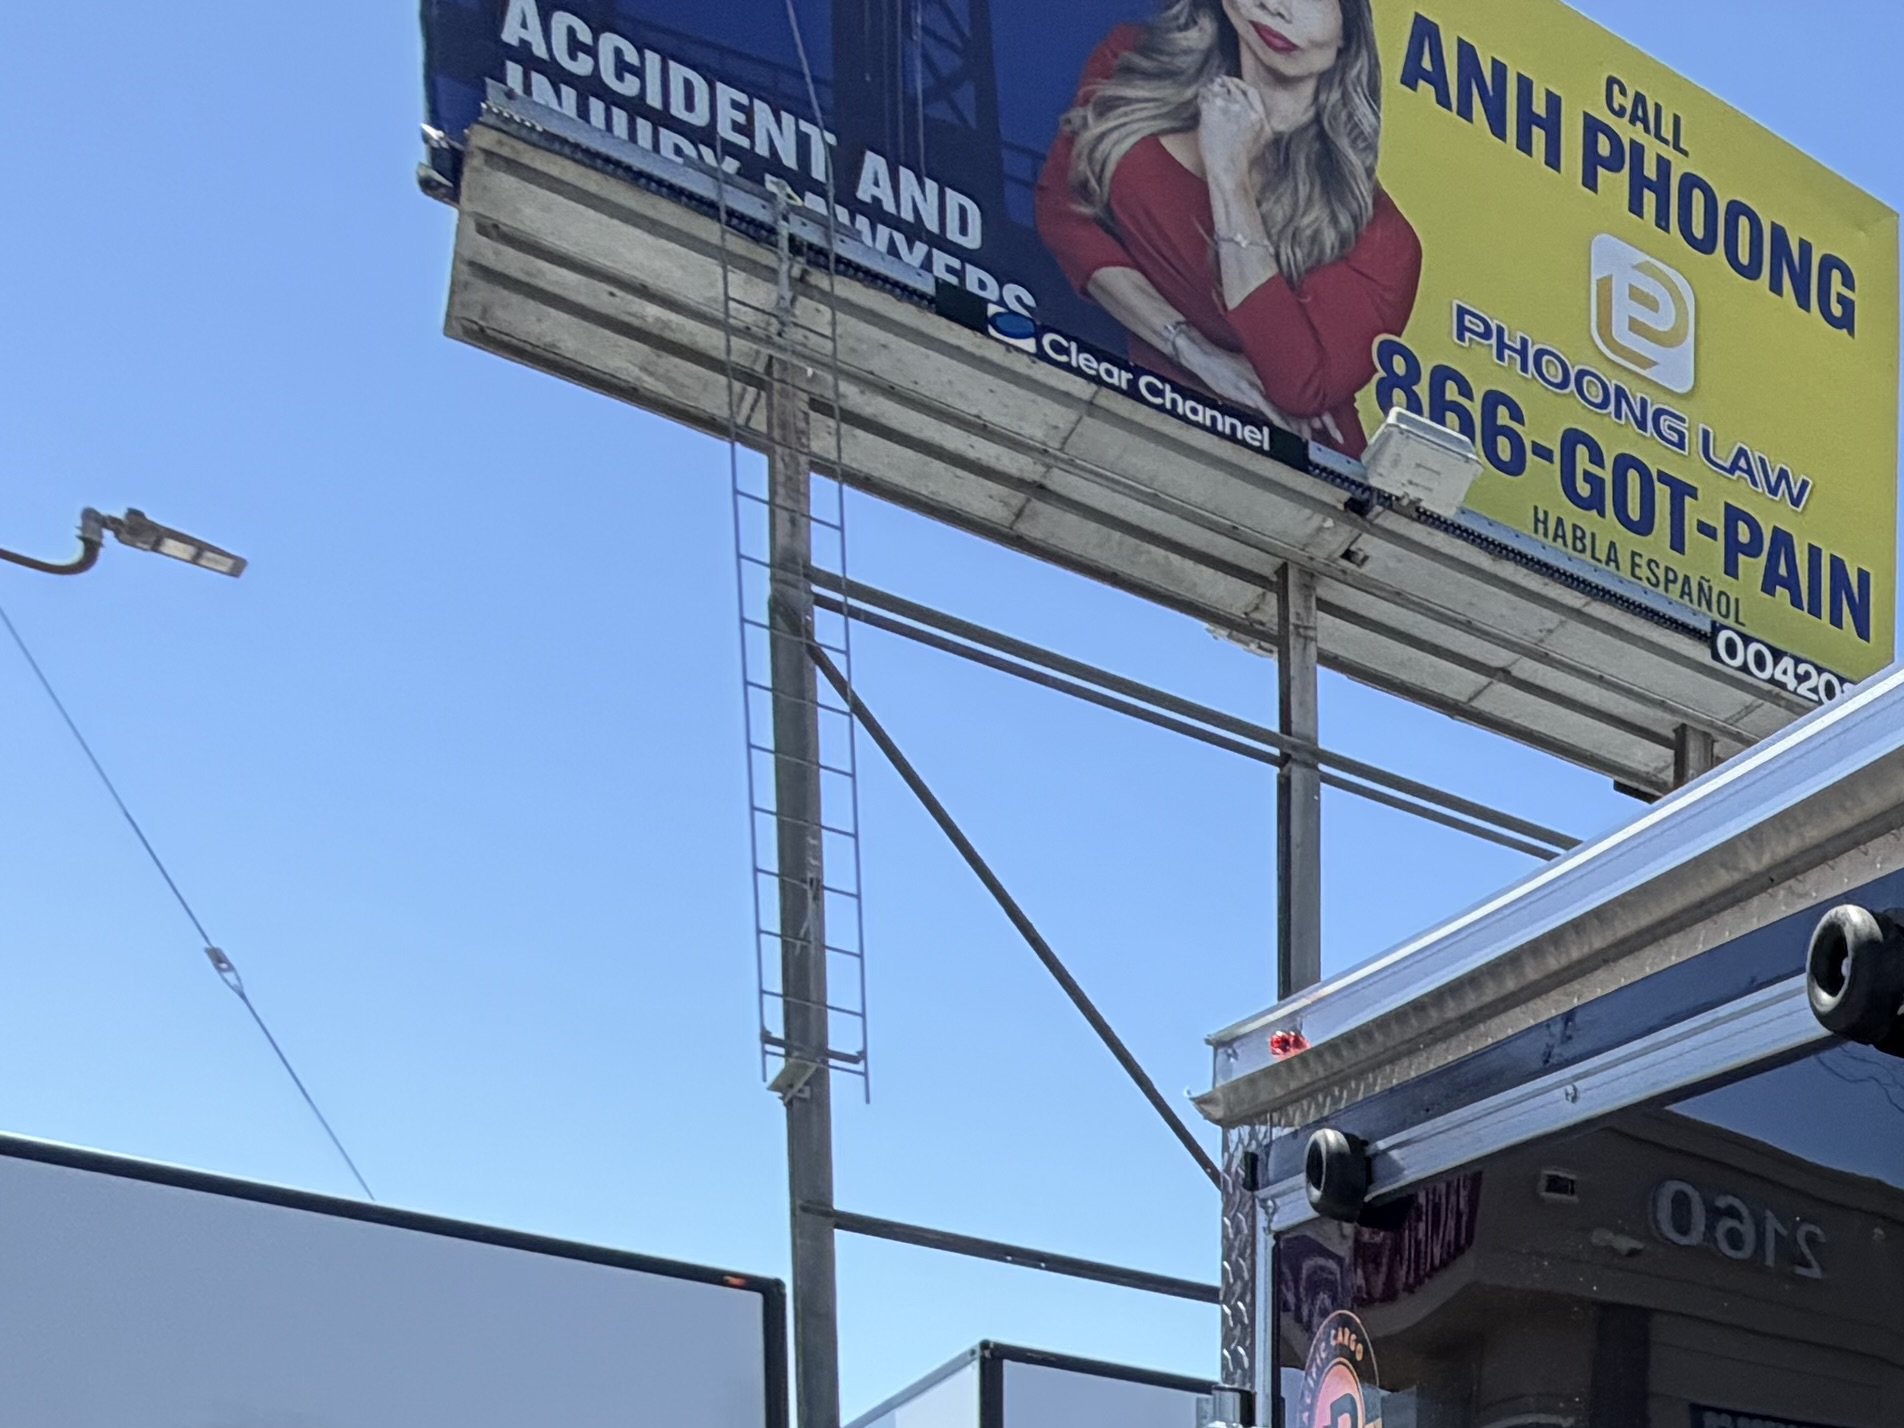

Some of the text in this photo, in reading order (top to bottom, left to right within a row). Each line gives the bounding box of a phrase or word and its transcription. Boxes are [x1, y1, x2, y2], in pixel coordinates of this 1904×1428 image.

[501, 0, 983, 250] ACCIDENT AND
[1400, 12, 1856, 339] ANH PHOONG
[1605, 75, 1690, 157] CALL
[1041, 332, 1270, 450] Clear Channel
[1452, 302, 1813, 512] PHOONG LAW
[1375, 338, 1872, 643] 866-GOT-PAIN
[1533, 505, 1746, 627] HABLA ESPAÑOL
[1716, 629, 1856, 704] 00420
